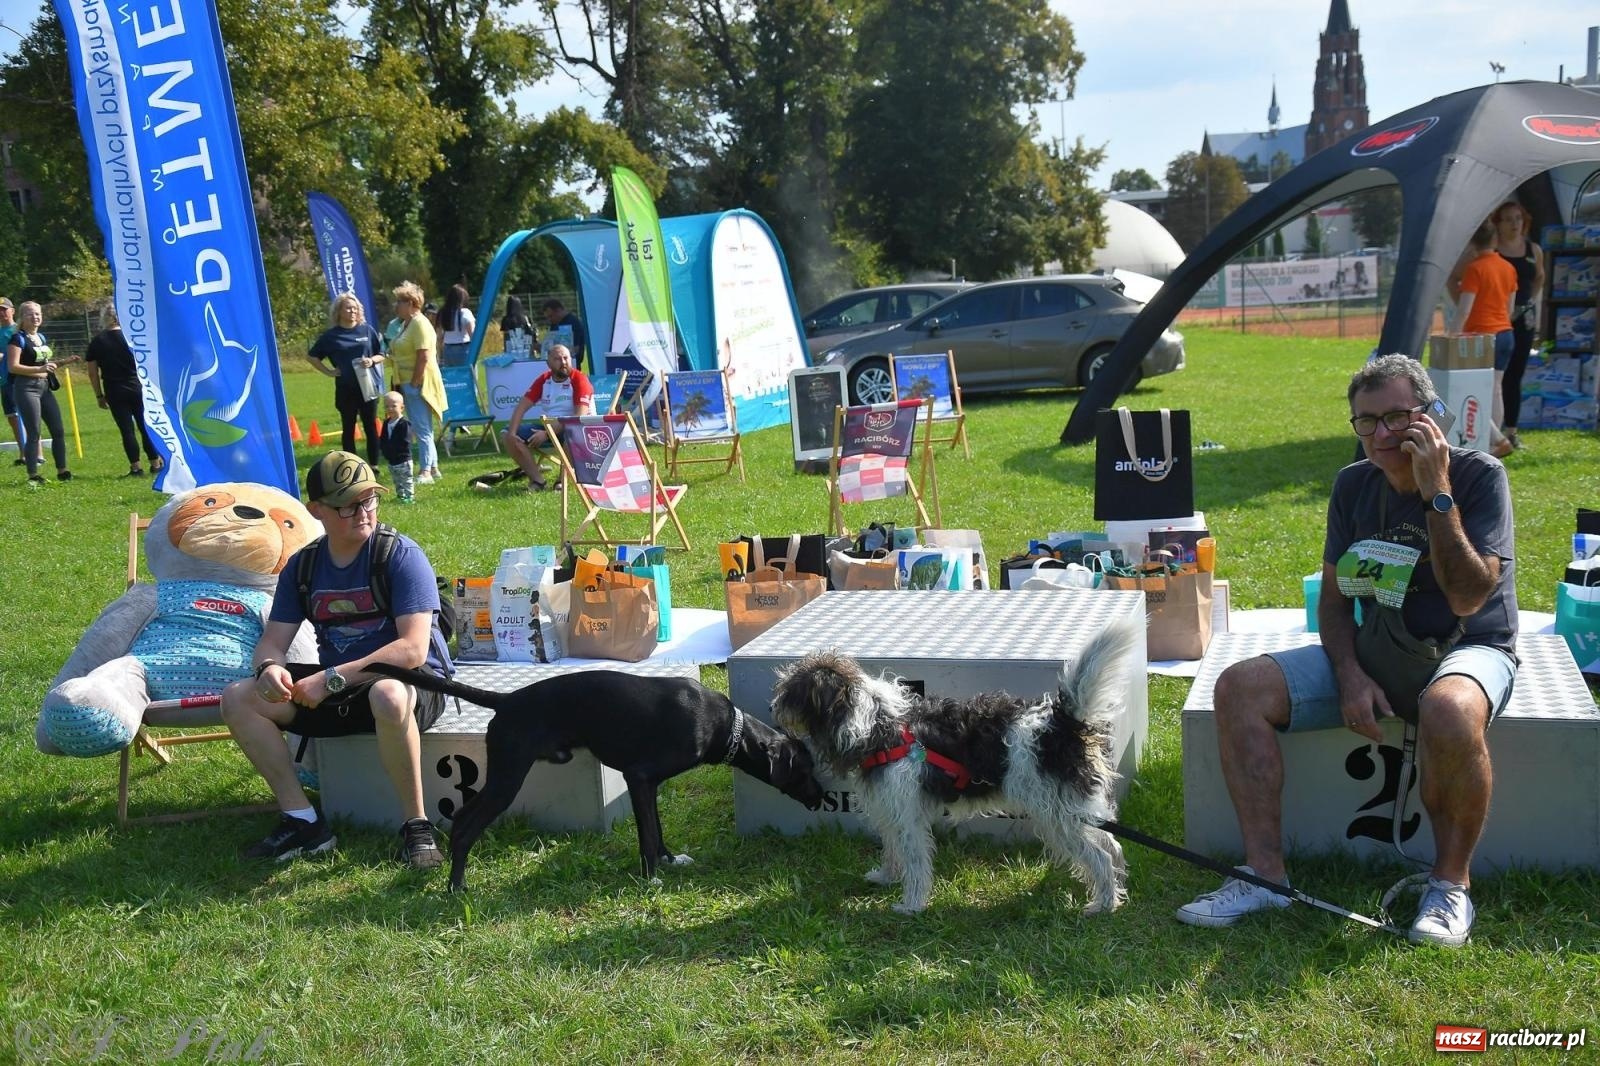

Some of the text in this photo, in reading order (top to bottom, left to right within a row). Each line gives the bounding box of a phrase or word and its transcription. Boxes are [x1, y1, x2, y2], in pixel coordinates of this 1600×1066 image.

[1466, 400, 1477, 440] flexi
[854, 434, 901, 446] RACIBÓRZ
[584, 462, 602, 470] RAC
[1115, 457, 1169, 473] amipla
[1356, 560, 1385, 581] 24
[201, 601, 238, 613] ZOLUX
[496, 616, 526, 624] ADULT
[436, 754, 486, 821] 3
[1345, 743, 1421, 844] 2
